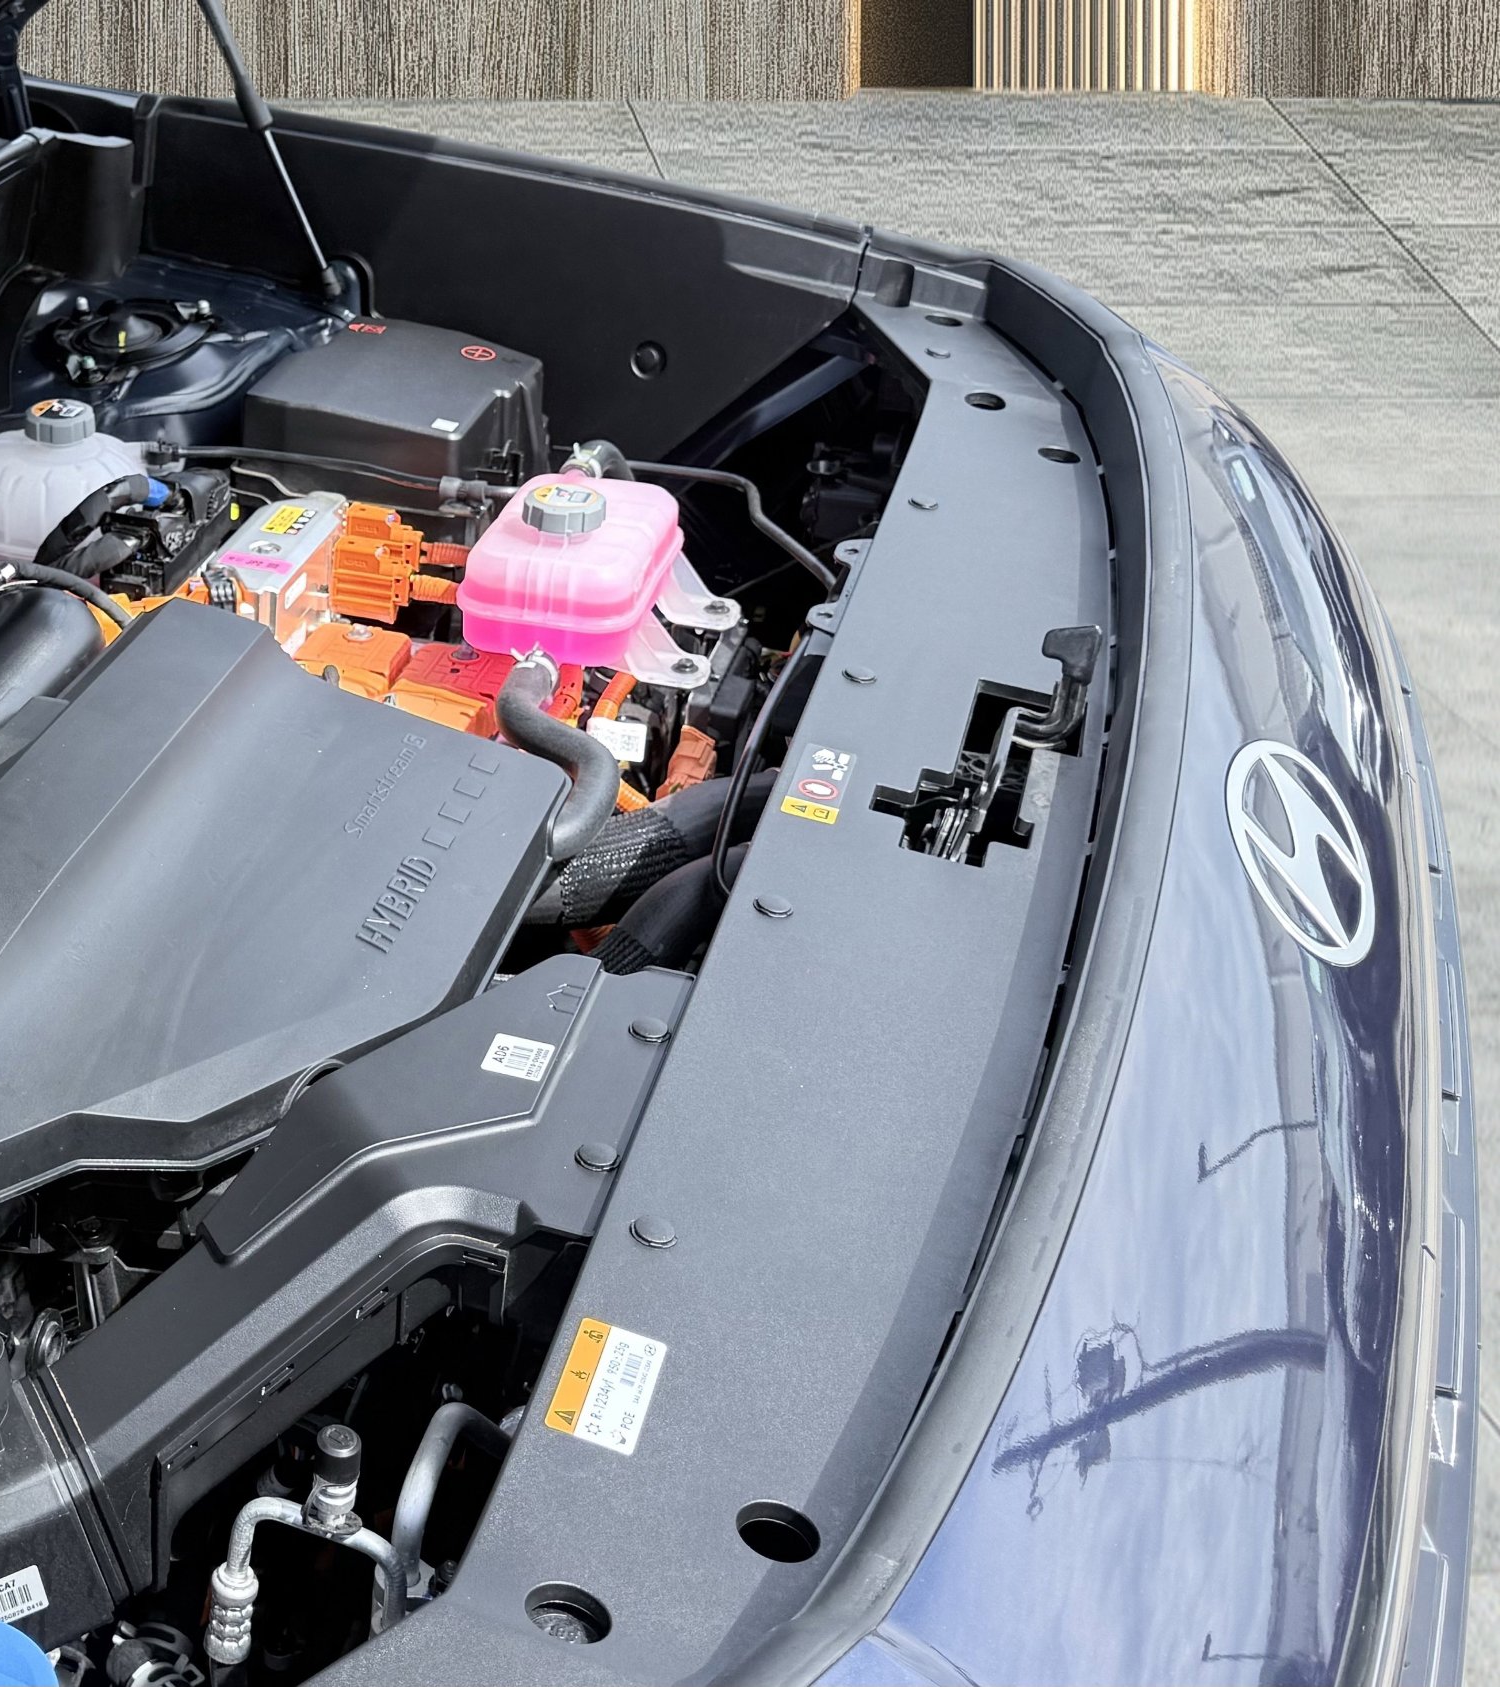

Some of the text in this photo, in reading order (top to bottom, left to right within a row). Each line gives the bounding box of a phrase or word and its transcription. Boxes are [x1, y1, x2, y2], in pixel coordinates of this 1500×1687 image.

[344, 747, 417, 839] Smartstream
[355, 854, 437, 954] HYBRID
[591, 1378, 616, 1421] R-1234yf
[620, 1411, 636, 1431] POE
